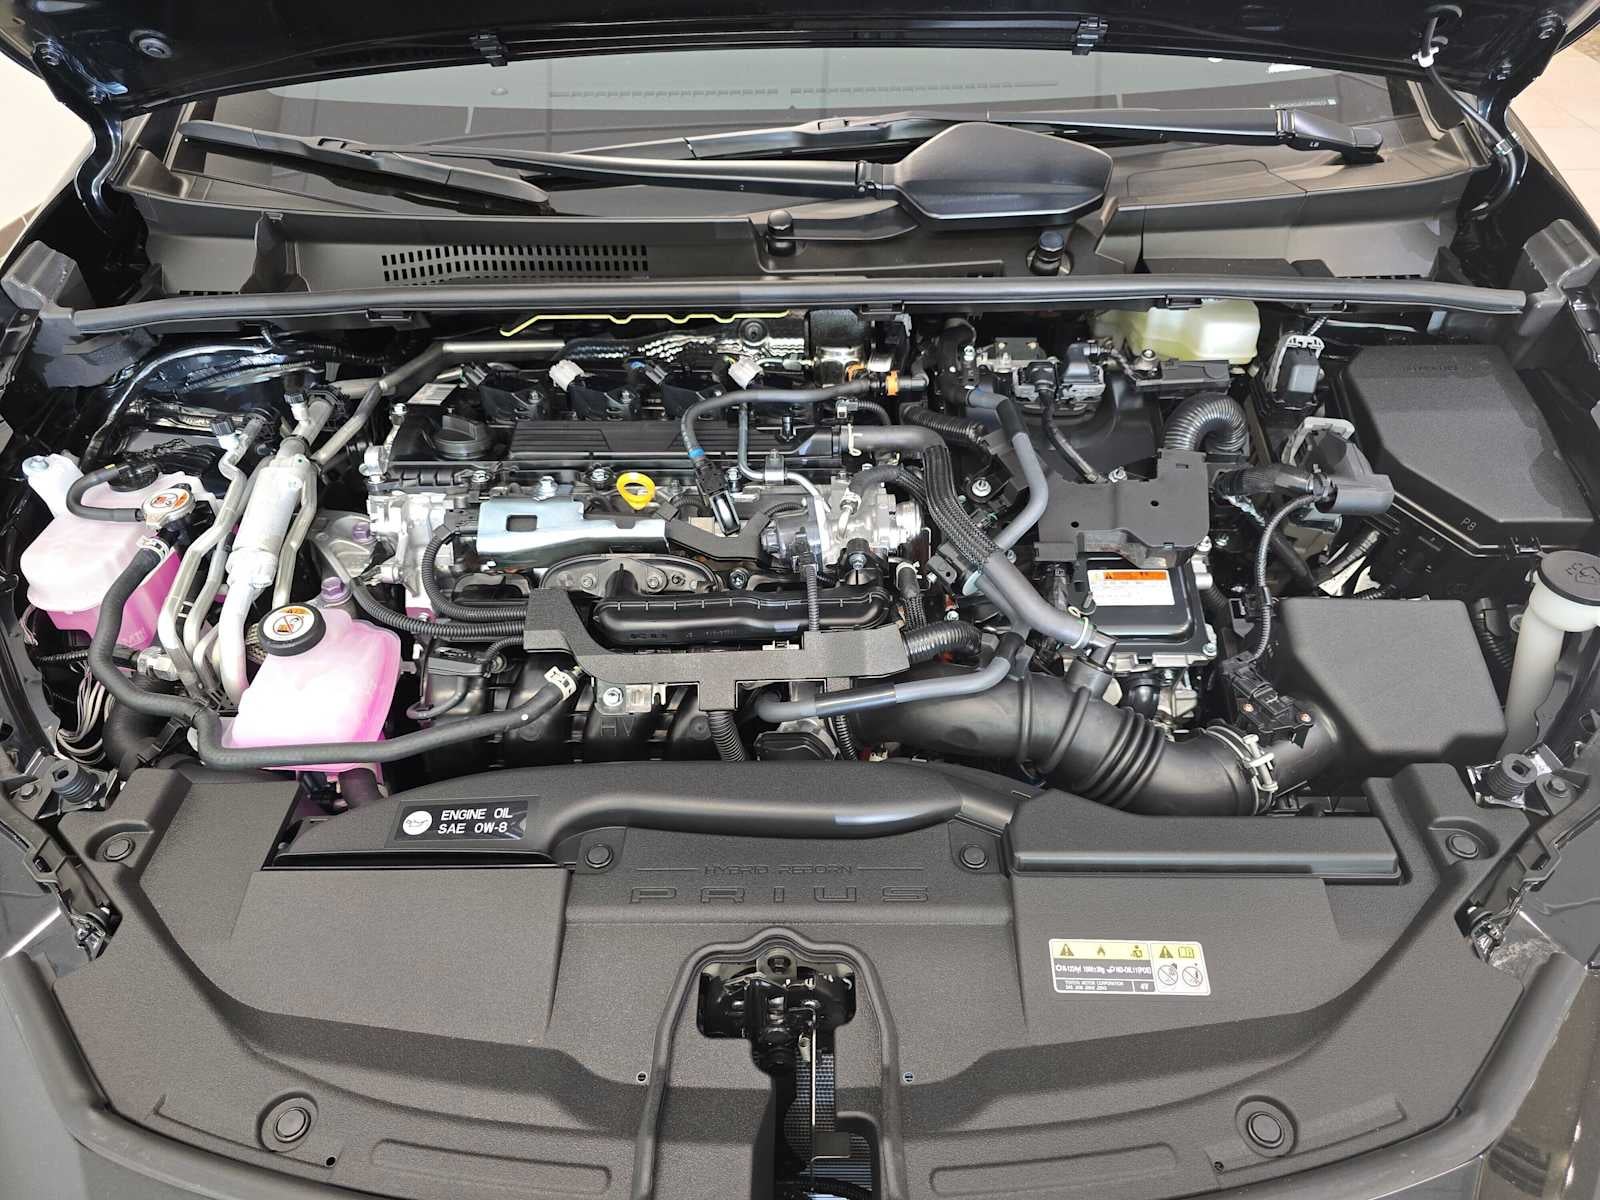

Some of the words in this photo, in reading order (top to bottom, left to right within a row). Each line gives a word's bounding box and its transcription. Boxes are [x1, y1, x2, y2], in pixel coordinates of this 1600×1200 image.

[441, 808, 487, 820] ENGINE
[494, 807, 513, 818] OIL
[438, 823, 466, 834] SAE
[474, 822, 508, 833] 0W-8
[704, 864, 769, 874] HYBRID
[630, 886, 928, 903] PRIUS
